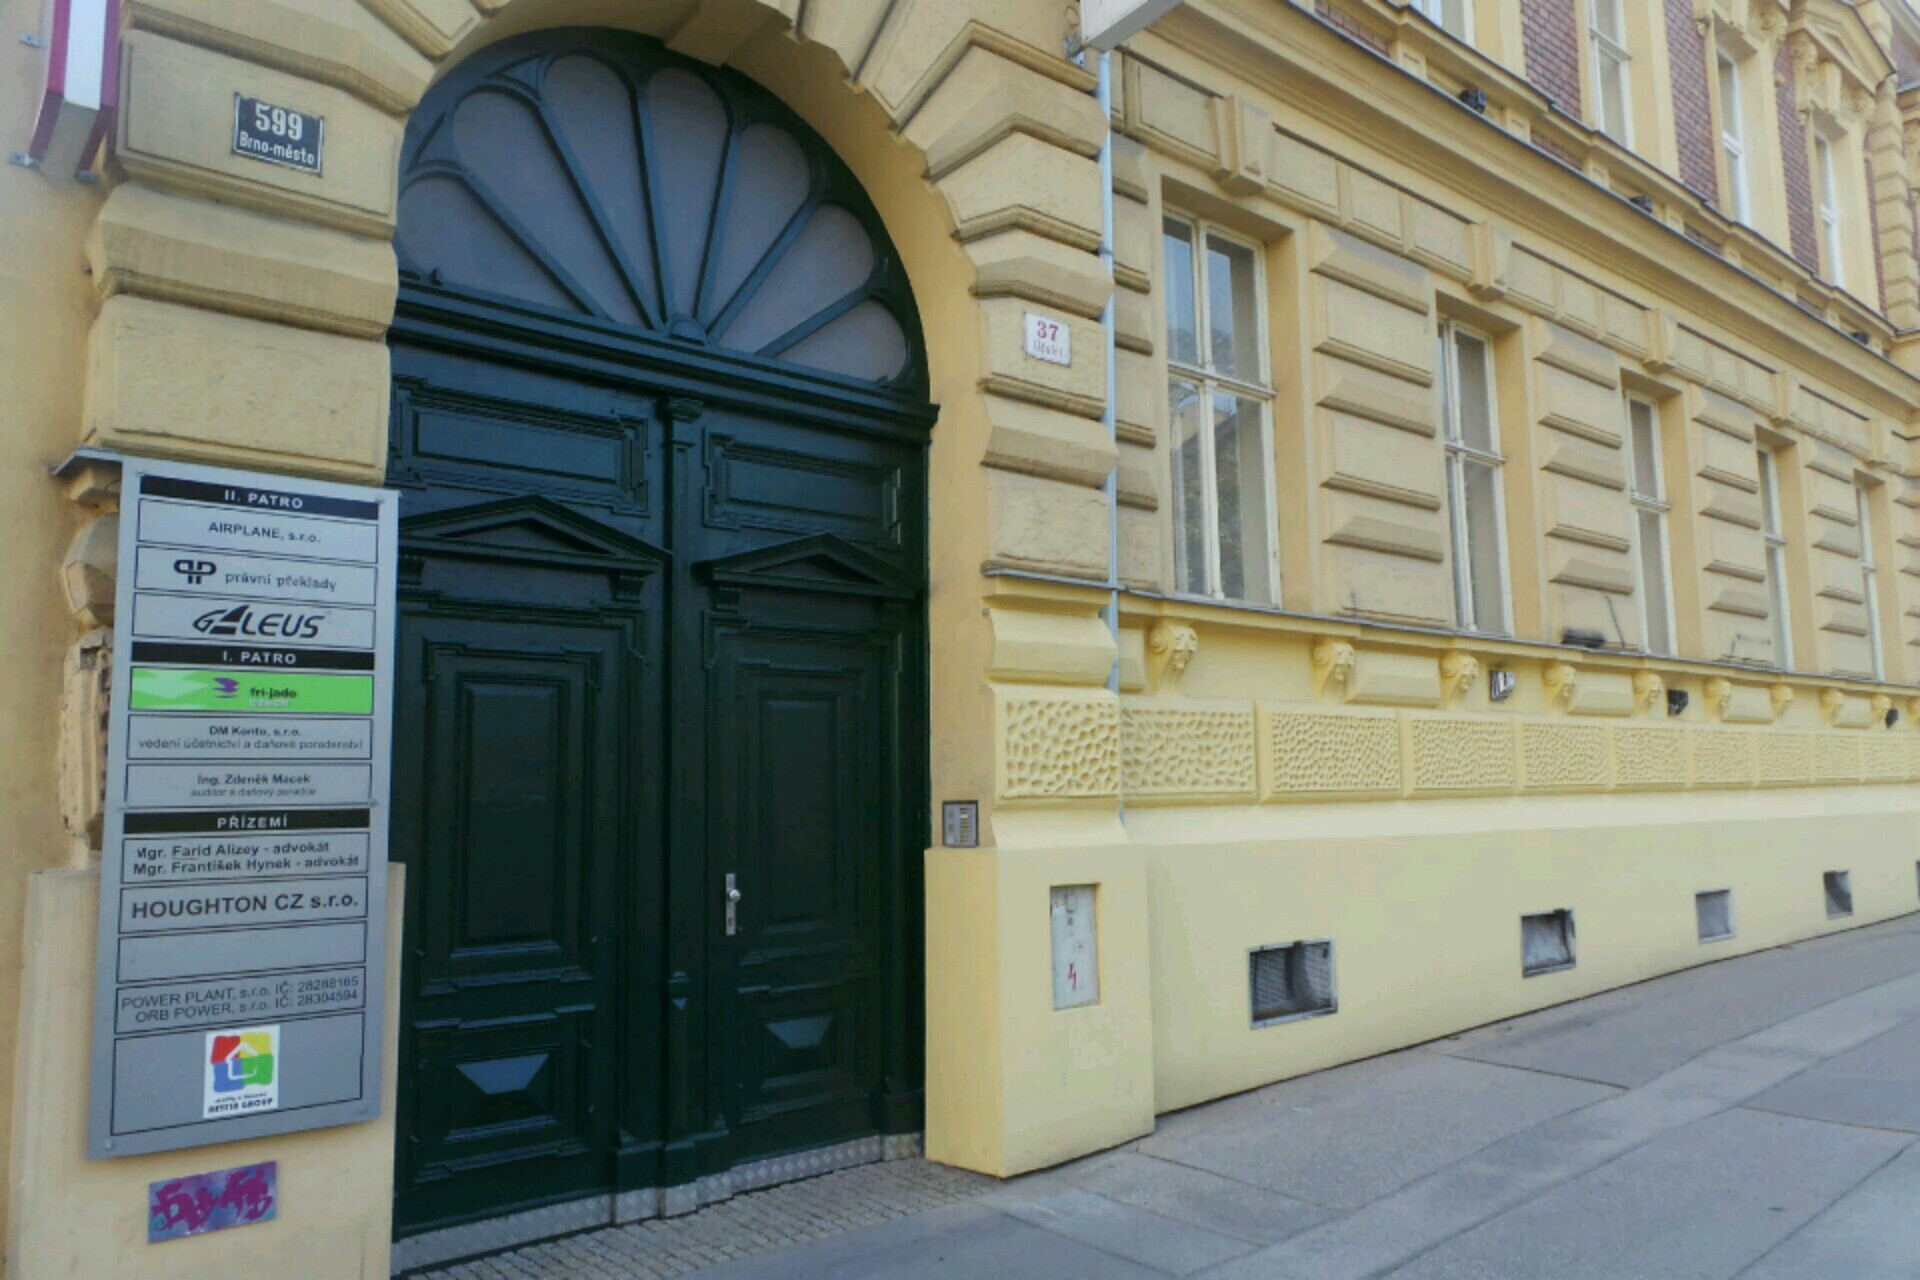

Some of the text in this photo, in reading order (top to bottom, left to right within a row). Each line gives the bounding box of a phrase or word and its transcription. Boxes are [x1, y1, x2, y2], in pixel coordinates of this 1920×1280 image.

[255, 102, 303, 140] 599
[1037, 319, 1059, 342] 37
[224, 489, 303, 509] II. PATRO
[208, 521, 321, 544] AIRPLANE, s.r.o.
[224, 571, 271, 585] právní
[277, 575, 337, 592] překlady
[222, 650, 297, 665] I. PATRO
[208, 725, 229, 736] DM
[138, 738, 181, 749] vedení
[243, 741, 251, 749] a
[197, 773, 220, 787] Ing.
[224, 773, 268, 786] Zdeněk
[217, 813, 288, 830] PŘÍZEMÍ
[137, 846, 167, 862] Mgr.
[172, 845, 212, 859] Farid
[215, 844, 260, 859] Alizey
[273, 841, 330, 855] advokát
[133, 861, 166, 877] Mgr.
[171, 859, 242, 874] František
[246, 857, 292, 873] Hynek
[305, 854, 360, 868] advokát
[131, 893, 359, 919] HOUGHTON CZ s.r.o.
[120, 993, 181, 1011] POWER
[185, 987, 236, 1003] PLANT,
[239, 986, 270, 999] s.r.o.
[135, 1007, 170, 1023] ORB
[174, 1002, 235, 1019] POWER,
[239, 1000, 270, 1013] s.r.o.
